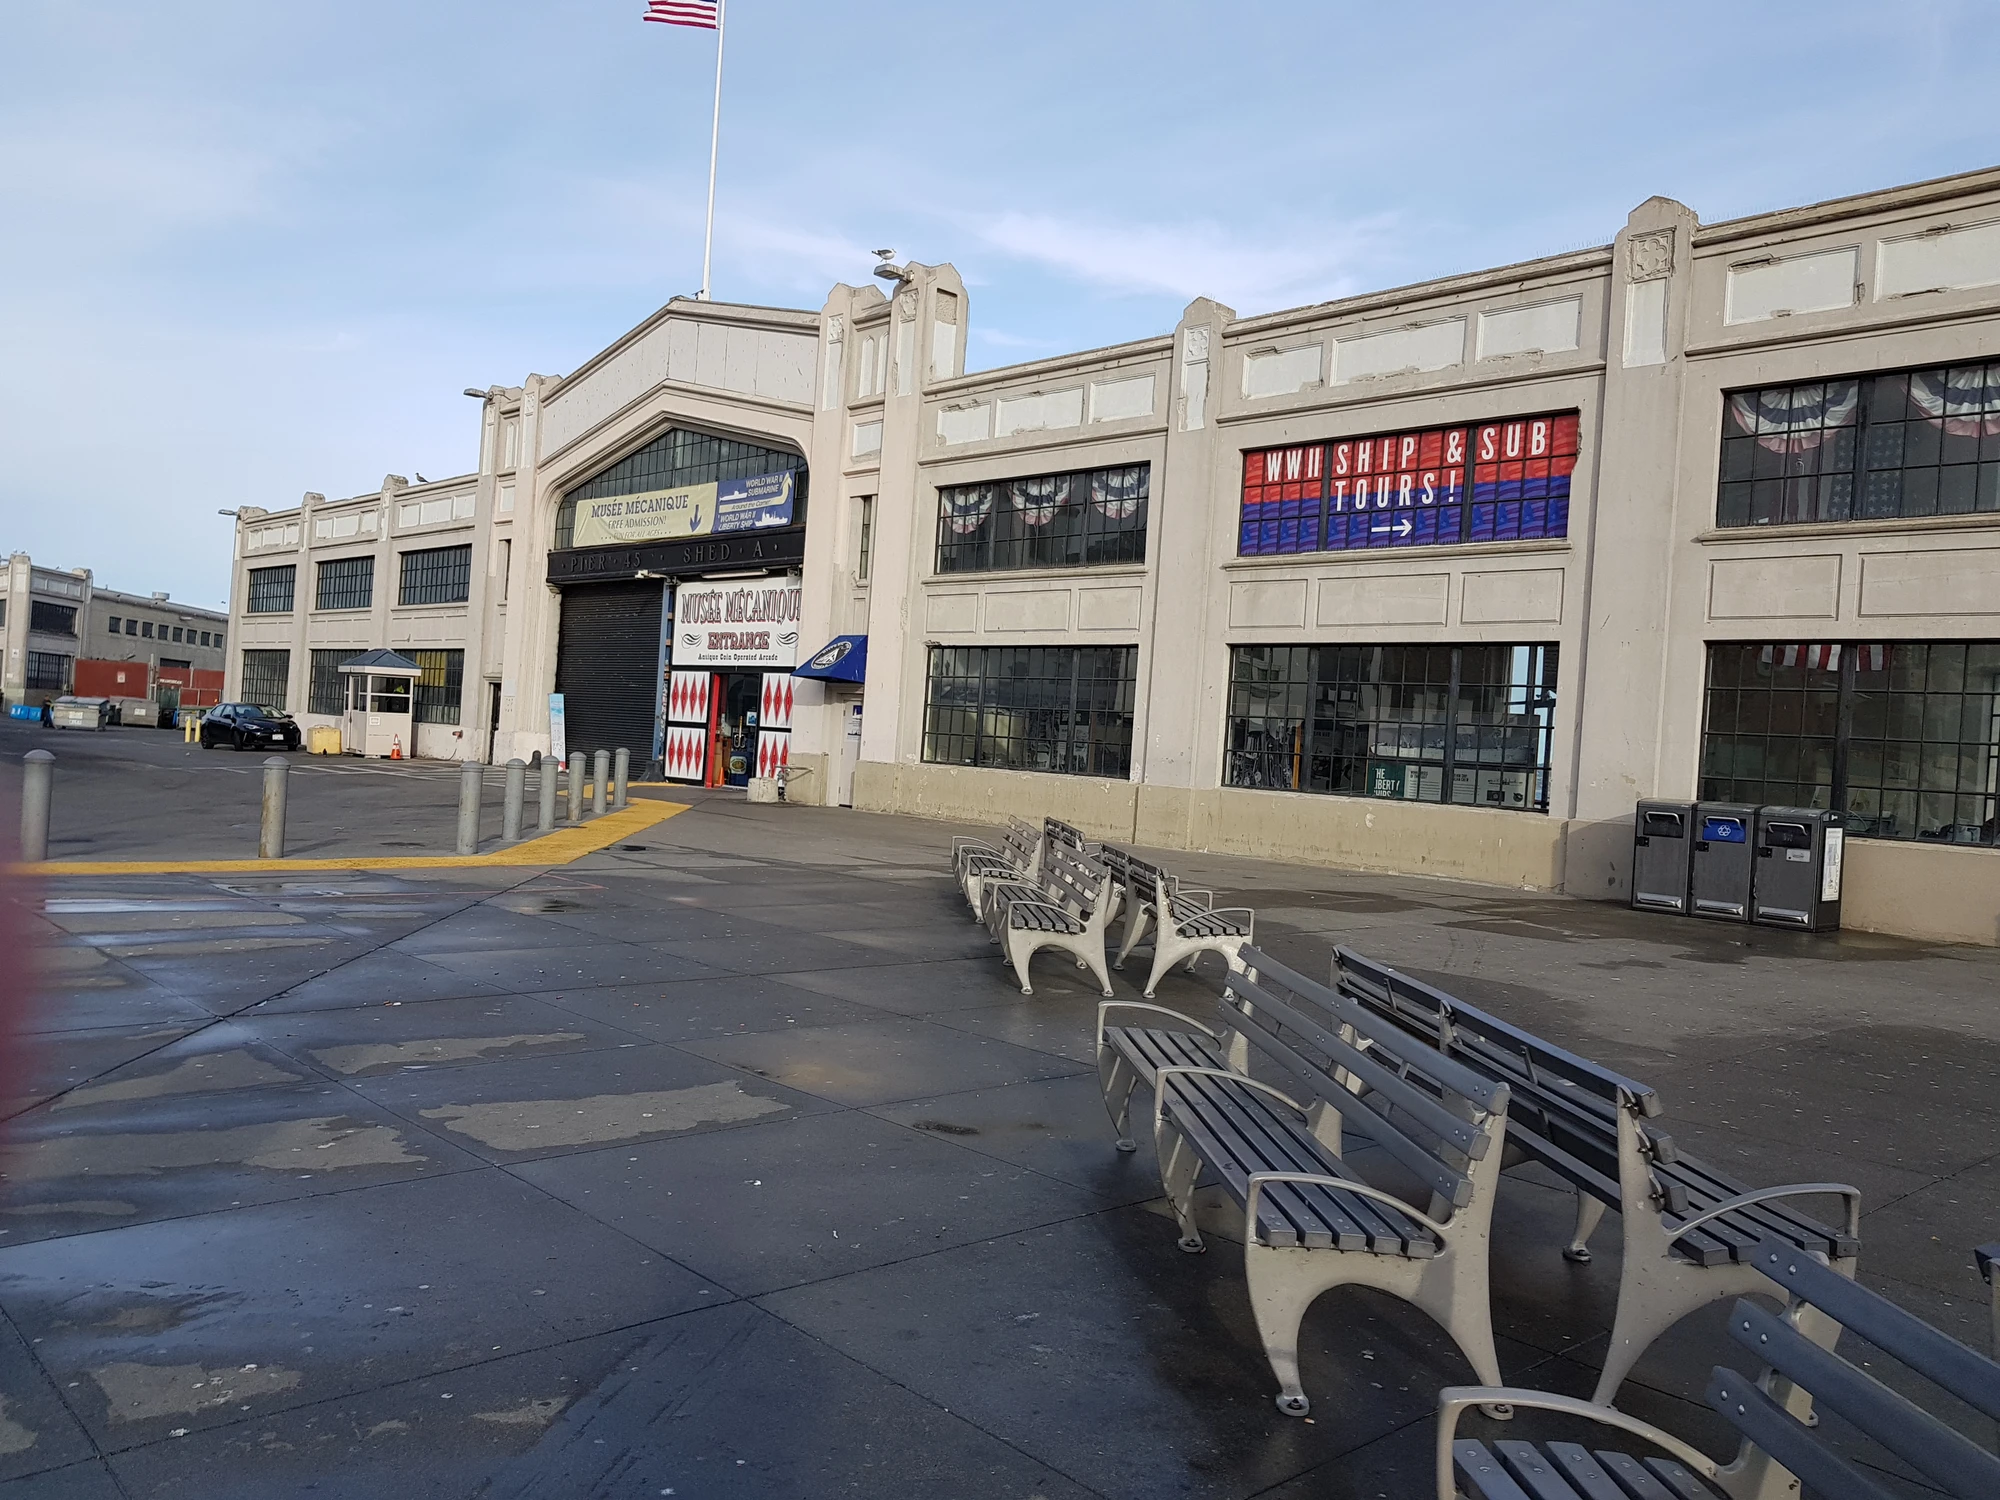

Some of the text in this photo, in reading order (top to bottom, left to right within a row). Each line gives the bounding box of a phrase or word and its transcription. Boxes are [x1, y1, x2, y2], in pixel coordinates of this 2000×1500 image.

[1266, 421, 1546, 482] WWII SHIP & SUB
[746, 478, 765, 488] WORLD
[766, 475, 778, 485] WAR
[748, 484, 779, 497] SUBMARINE
[1334, 470, 1456, 512] TOURS!
[591, 495, 689, 518] MUSÉE MÉCANIQUE
[731, 503, 748, 511] Around
[608, 515, 667, 530] FREE ADMISSION!
[720, 513, 739, 523] WORLD
[740, 511, 752, 520] WAR
[718, 519, 754, 531] LIBERTY SHIP
[570, 540, 763, 572] PIER 45 SHED A
[681, 588, 723, 625] MUSÉE
[707, 630, 770, 650] ENTRANCE
[698, 653, 778, 662] Antique Coin Operated Arcade
